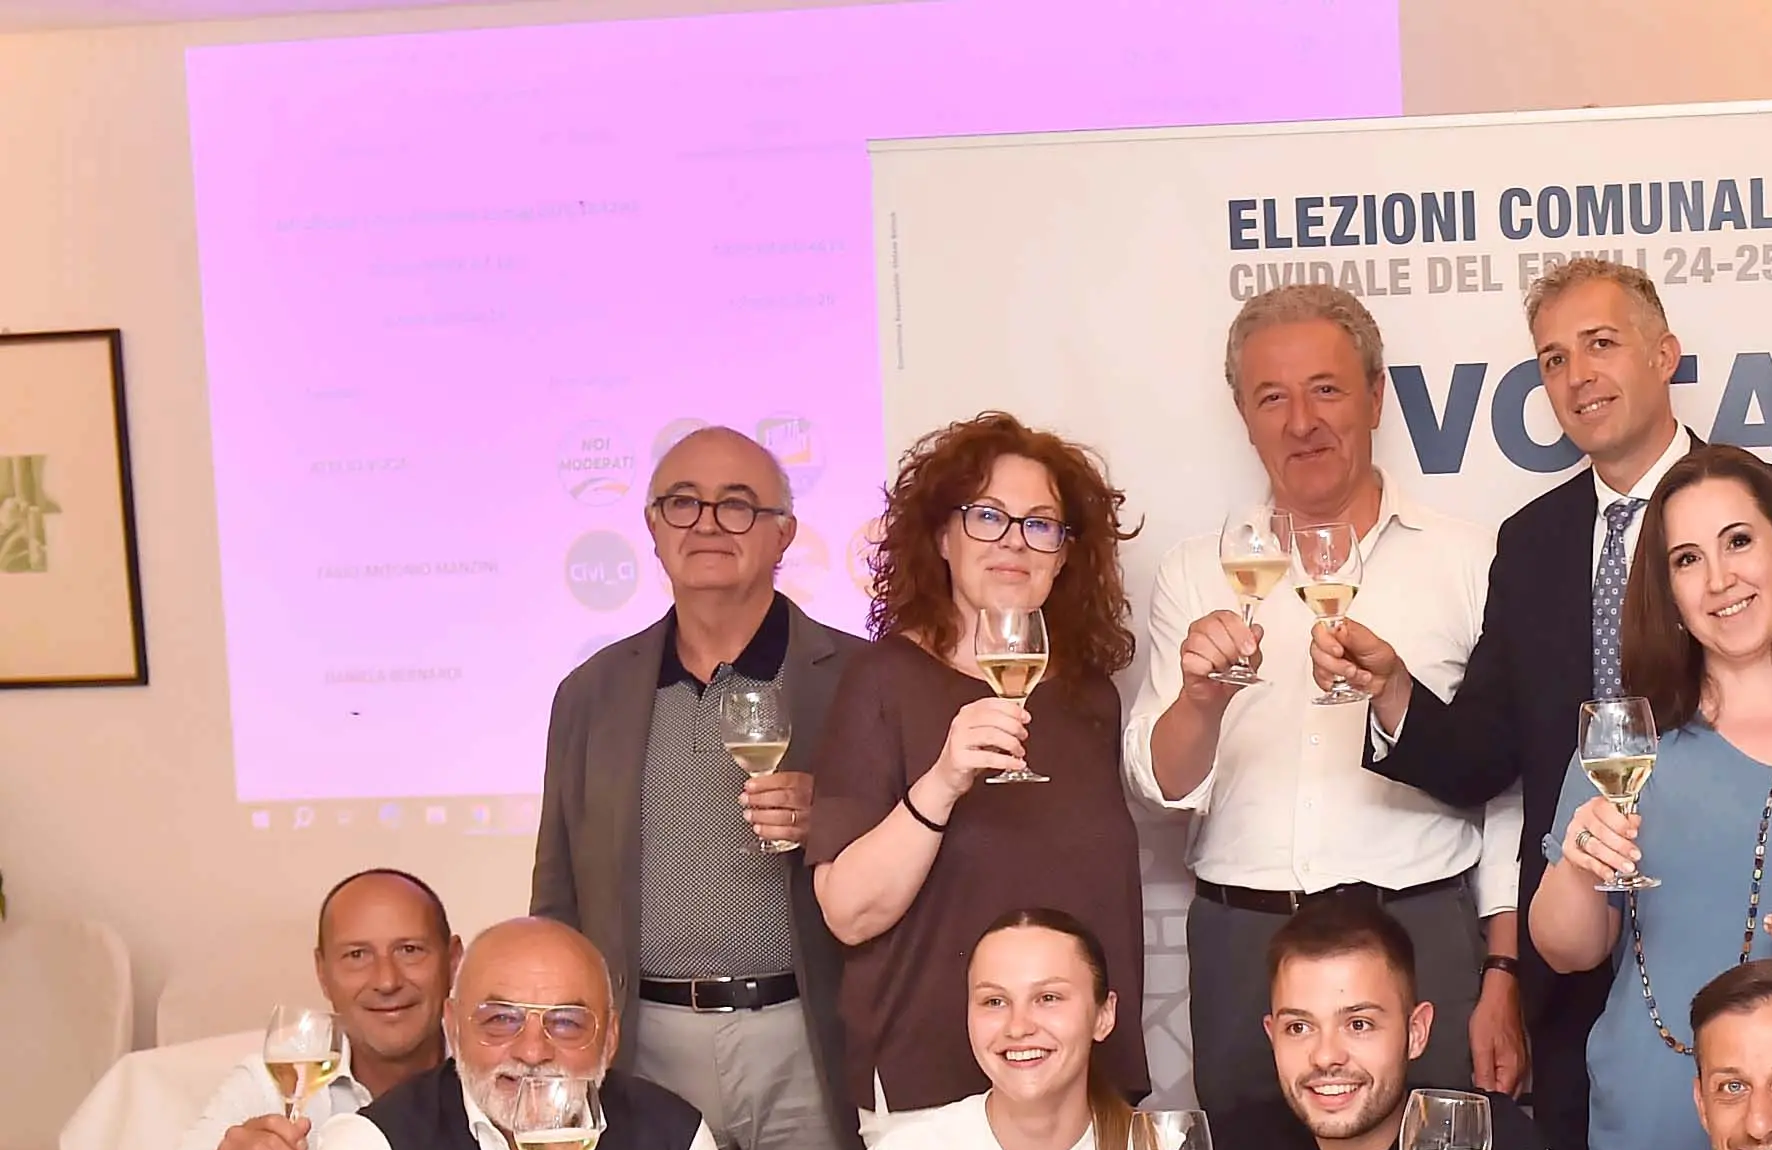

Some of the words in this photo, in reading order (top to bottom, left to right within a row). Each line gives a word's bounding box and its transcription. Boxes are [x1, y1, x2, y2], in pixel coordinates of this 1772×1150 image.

[1229, 191, 1476, 250] ELEZIONI
[1229, 258, 1412, 301] CIVIDALE
[1428, 255, 1503, 294] DEL
[581, 438, 611, 451] NOI
[560, 456, 634, 472] MODERATI
